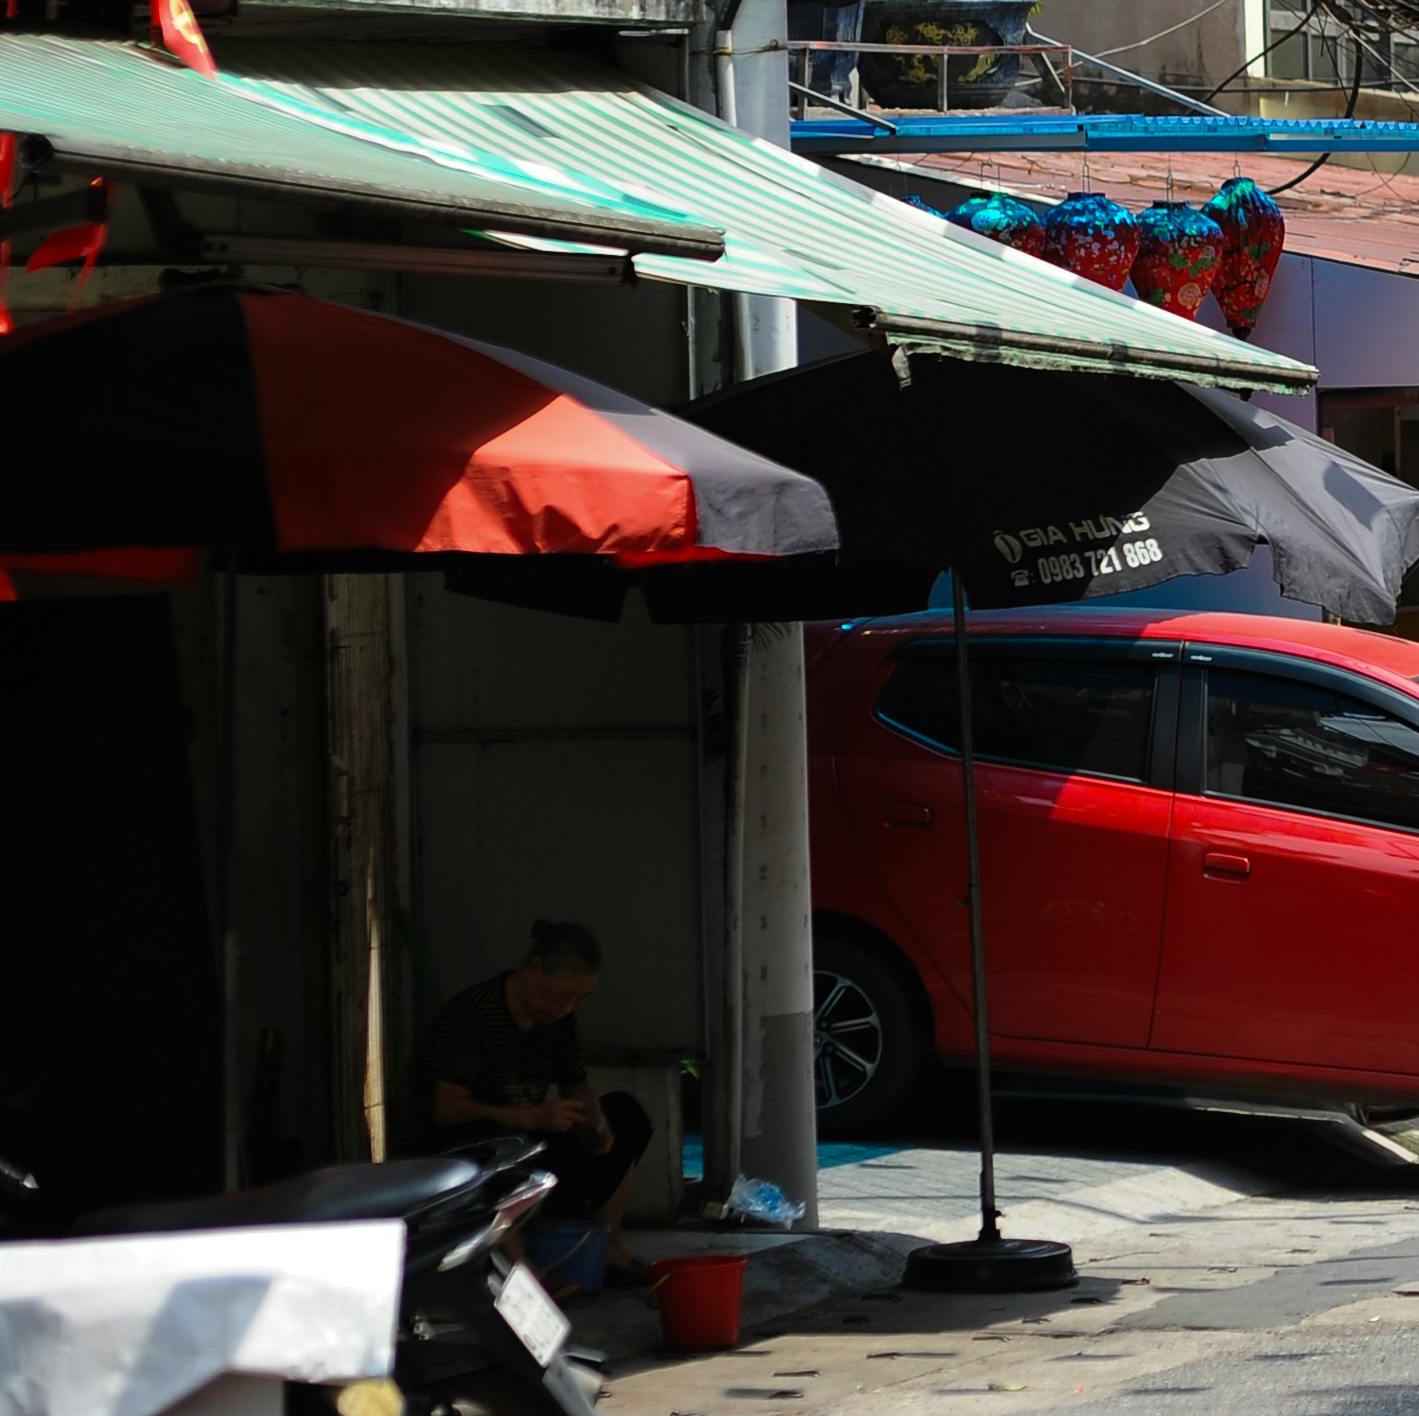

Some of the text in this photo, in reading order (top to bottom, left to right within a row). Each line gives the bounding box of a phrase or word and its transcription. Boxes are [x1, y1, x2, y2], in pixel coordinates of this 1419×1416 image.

[1018, 527, 1067, 548] GIA
[1037, 537, 1164, 584] 0983 721 868
